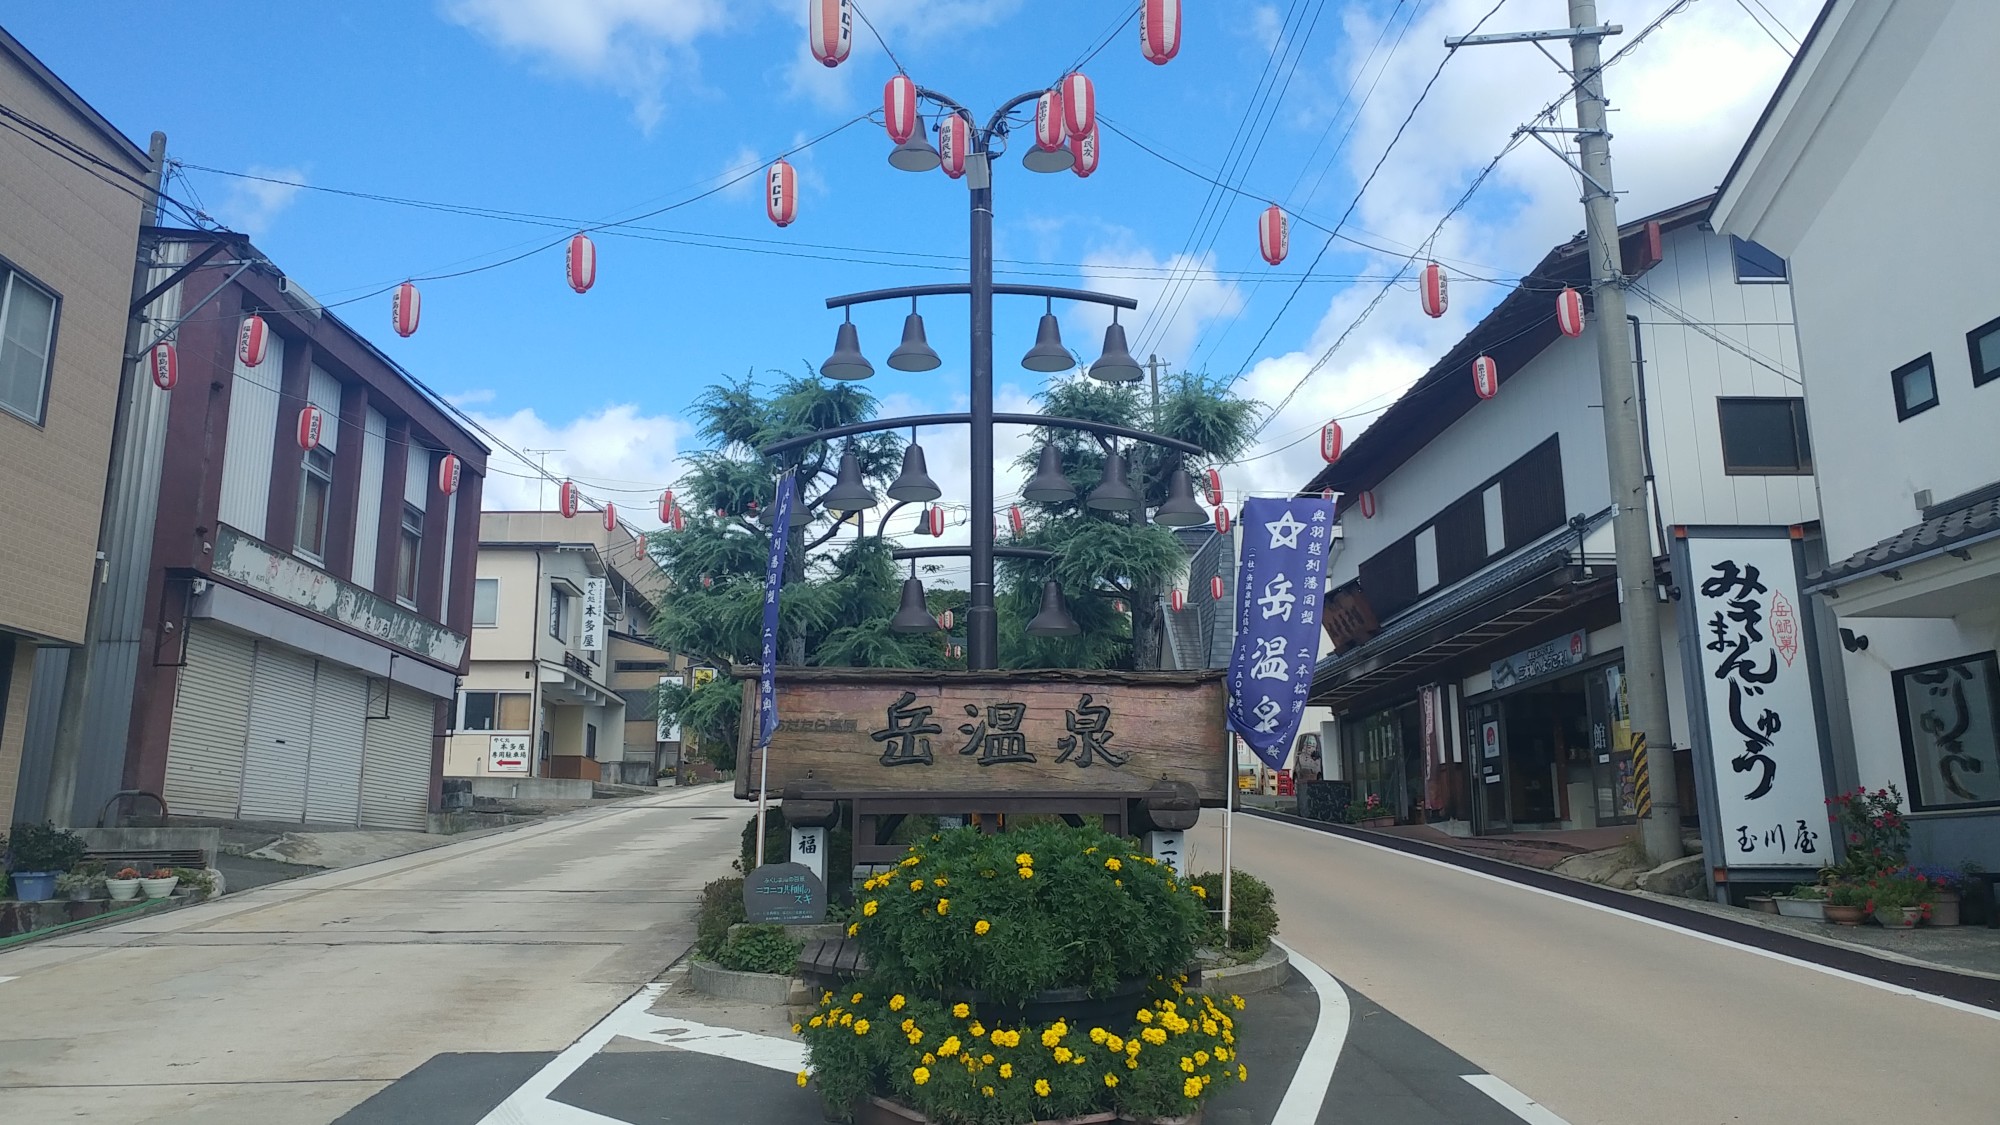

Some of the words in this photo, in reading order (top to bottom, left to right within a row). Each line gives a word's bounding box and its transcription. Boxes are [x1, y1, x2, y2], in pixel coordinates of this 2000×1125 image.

[771, 172, 782, 207] FCT
[241, 325, 251, 353] 福島民友
[158, 352, 168, 378] 福島民友
[1300, 509, 1327, 625] 奥羽越列藩同盟
[582, 604, 597, 647] 本多屋
[1250, 572, 1297, 734] 岳温泉
[1701, 560, 1781, 800] みそまんじゅう
[1265, 647, 1310, 760] 二本松藩敷
[870, 691, 1130, 768] 岳温泉
[798, 834, 817, 855] 福
[1736, 819, 1818, 855] 玉川屋
[763, 875, 806, 884] ふくしまの百景
